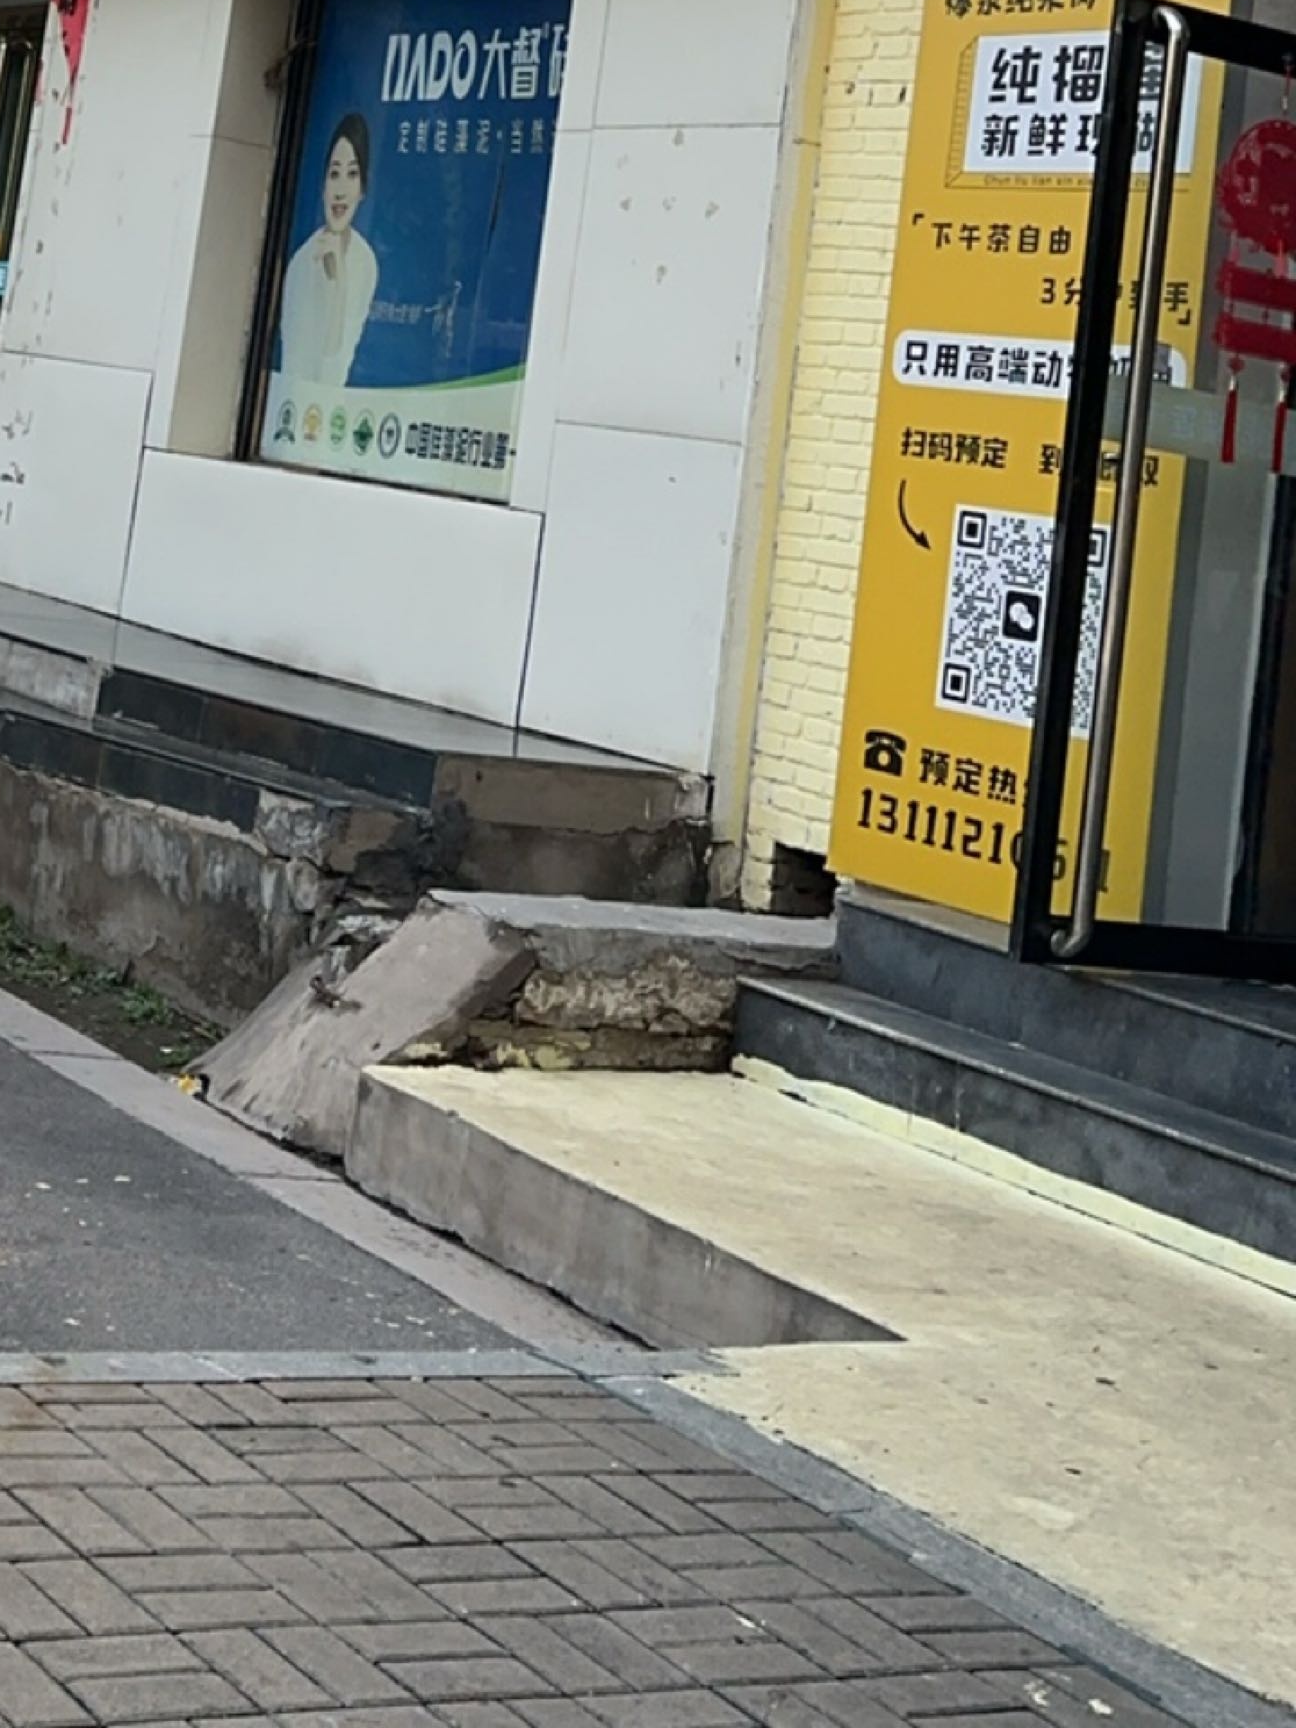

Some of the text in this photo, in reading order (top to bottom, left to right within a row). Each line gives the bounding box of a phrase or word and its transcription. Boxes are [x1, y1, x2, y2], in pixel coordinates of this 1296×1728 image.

[931, 221, 1072, 256] 下午茶自由
[900, 426, 1009, 470] 扫码预定
[918, 747, 1031, 806] 预定热
